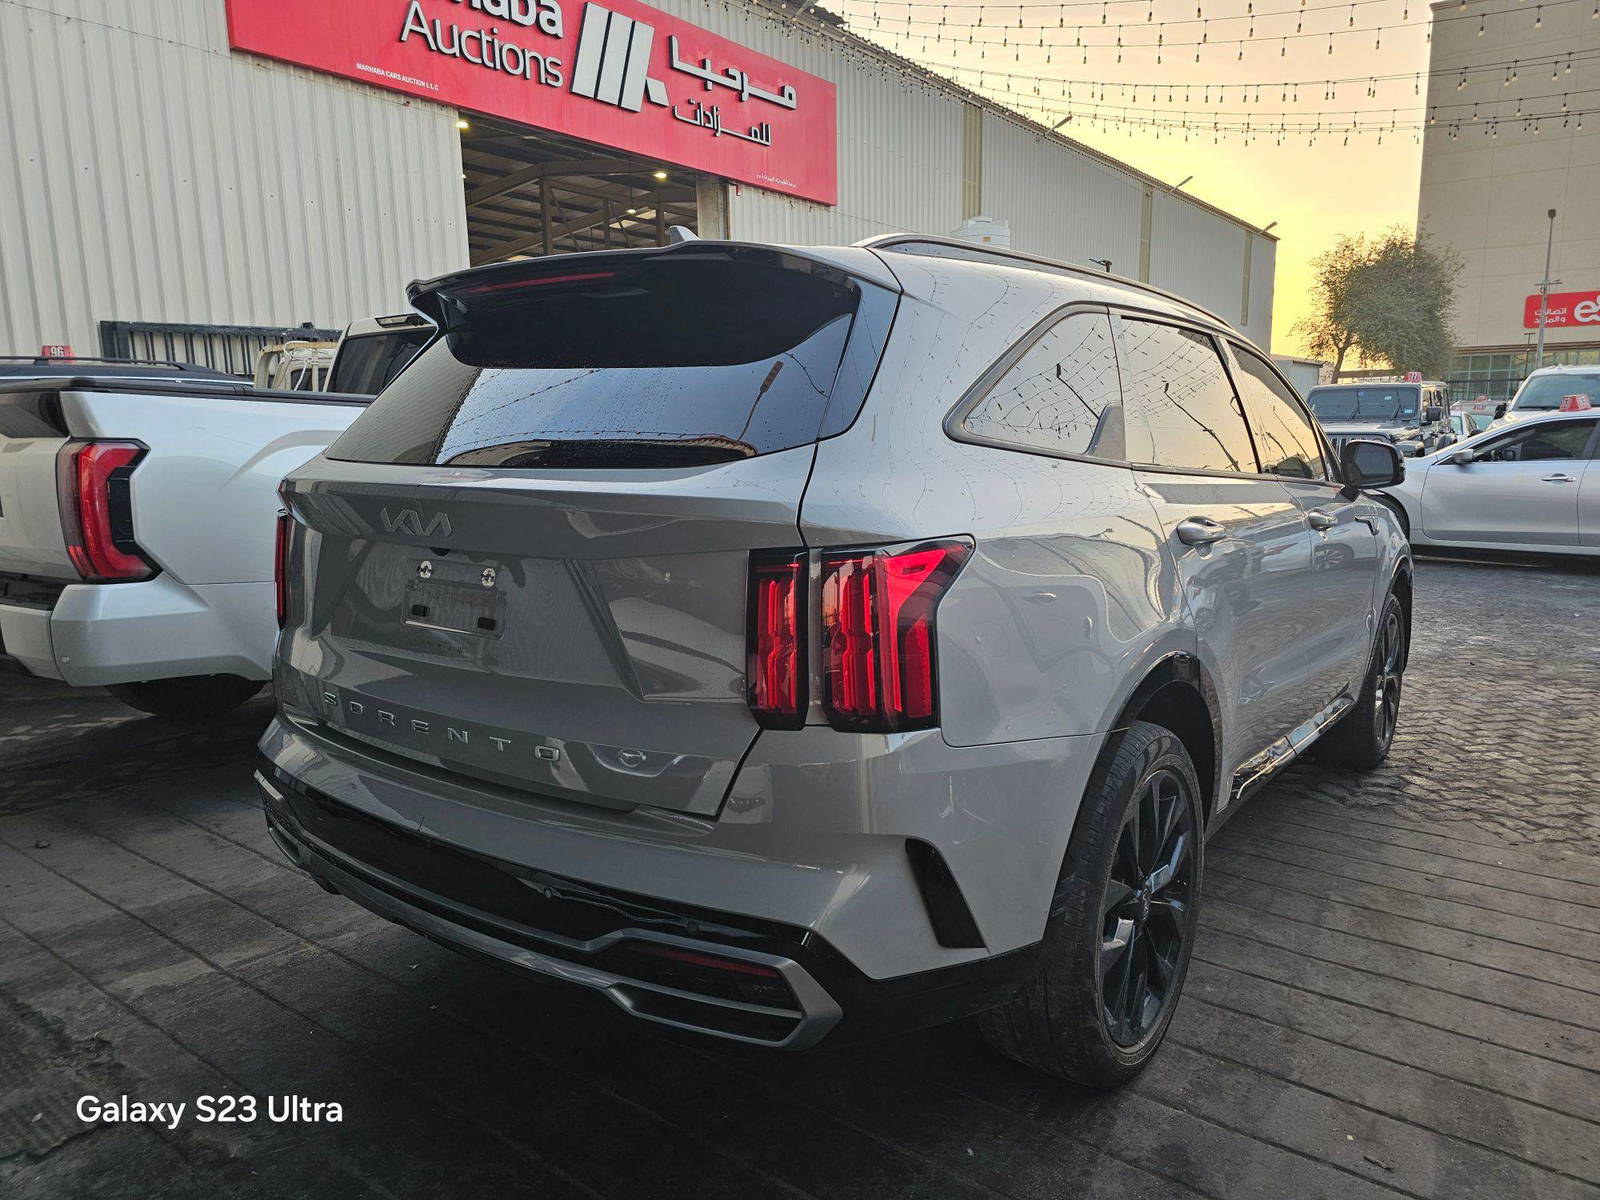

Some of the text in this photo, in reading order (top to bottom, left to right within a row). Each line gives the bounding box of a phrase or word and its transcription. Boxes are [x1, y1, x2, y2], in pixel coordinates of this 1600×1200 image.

[399, 0, 564, 88] Auctions
[402, 75, 426, 88] AUCTION
[669, 34, 797, 110] مرحبا
[50, 345, 65, 358] 96
[380, 506, 454, 537] KIA
[323, 691, 561, 762] SORENTO
